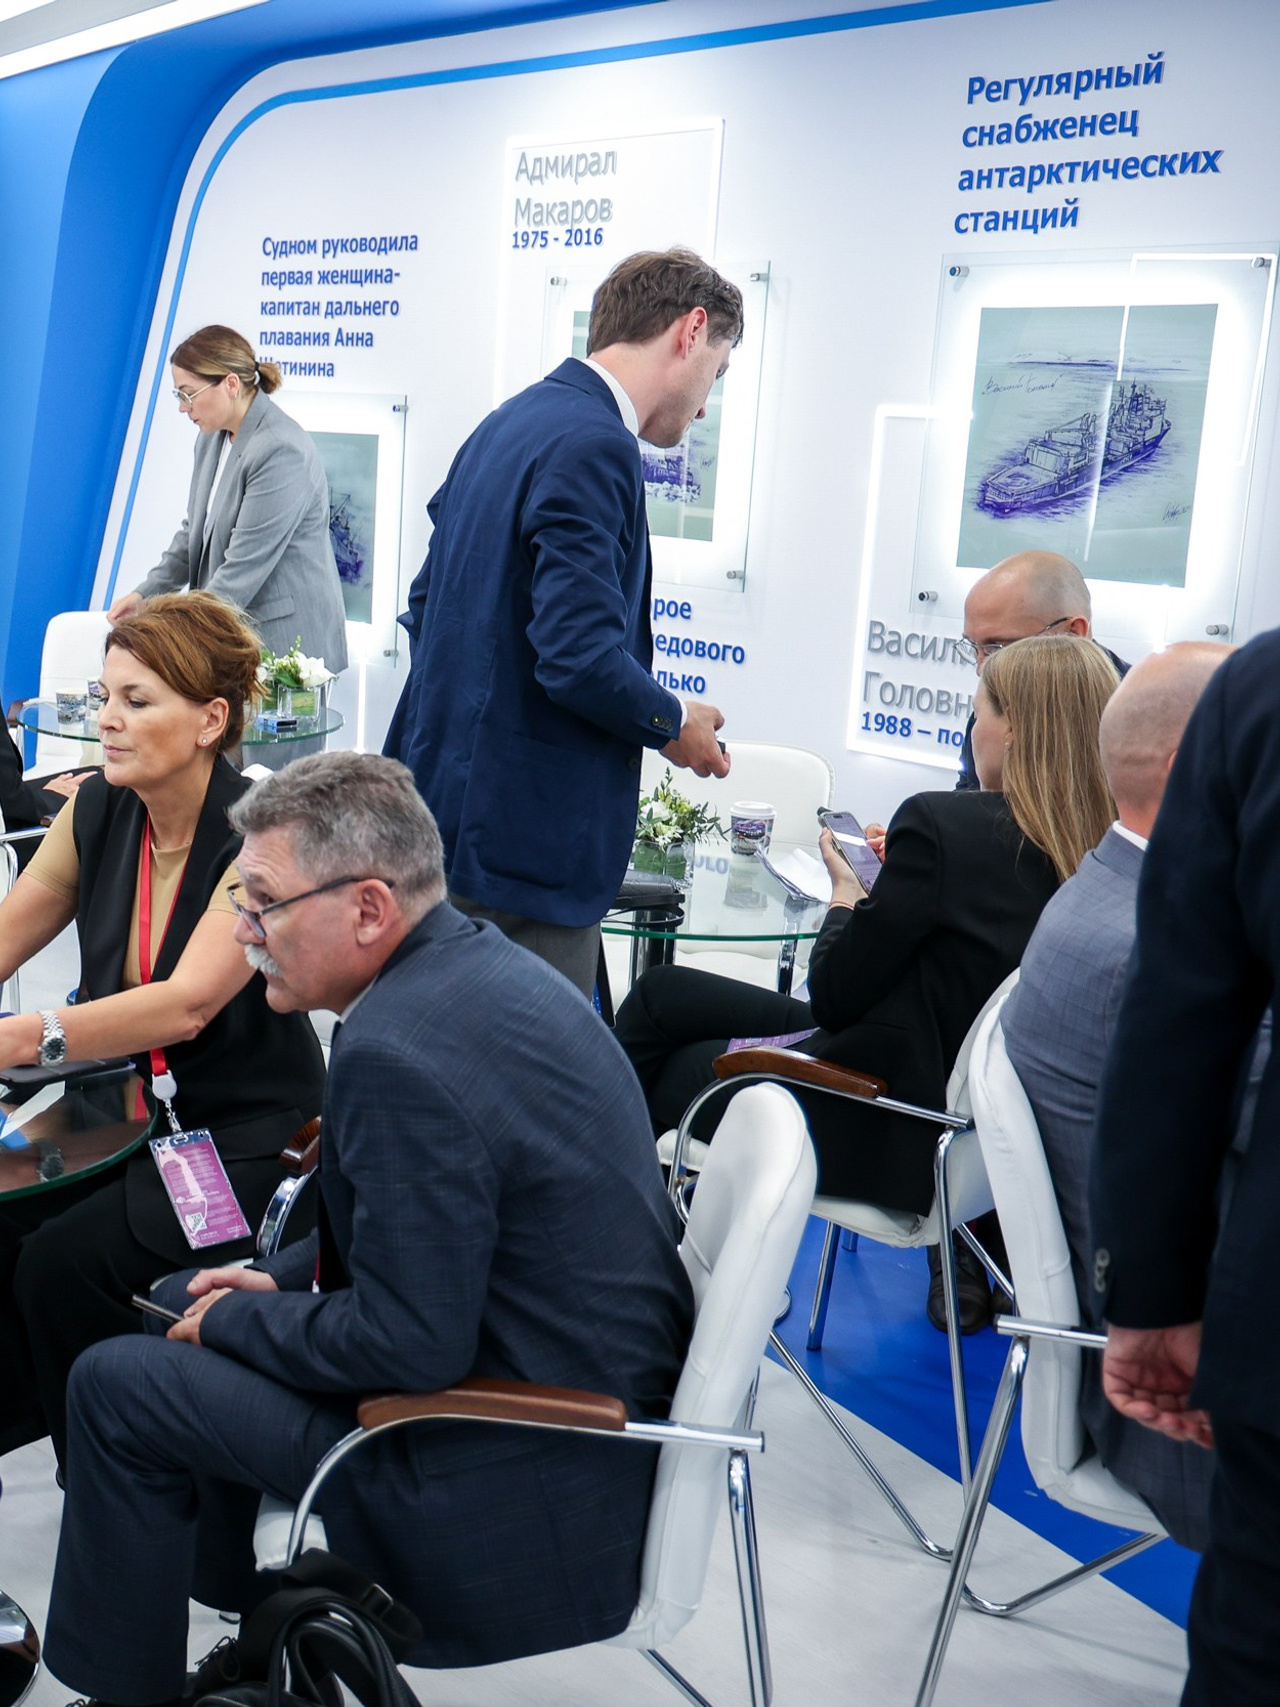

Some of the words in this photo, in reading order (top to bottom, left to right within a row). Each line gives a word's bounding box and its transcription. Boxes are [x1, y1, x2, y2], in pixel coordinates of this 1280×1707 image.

[967, 51, 1164, 105] Регулярный
[962, 109, 1139, 148] снабженец
[515, 151, 617, 185] Адмирал
[958, 150, 1223, 193] антарктических
[514, 197, 613, 228] Макаров
[954, 198, 1079, 234] станций
[262, 237, 317, 260] Судном
[322, 234, 418, 258] руководила
[512, 231, 548, 249] 1975
[564, 228, 603, 246] 2016
[261, 270, 312, 290] первая
[317, 267, 400, 288] женщина-
[260, 300, 320, 316] капитан
[324, 300, 399, 319] дальнего
[259, 330, 329, 346] плавания
[334, 327, 374, 347] Анна
[652, 633, 745, 664] едового
[861, 711, 912, 737] 1988
